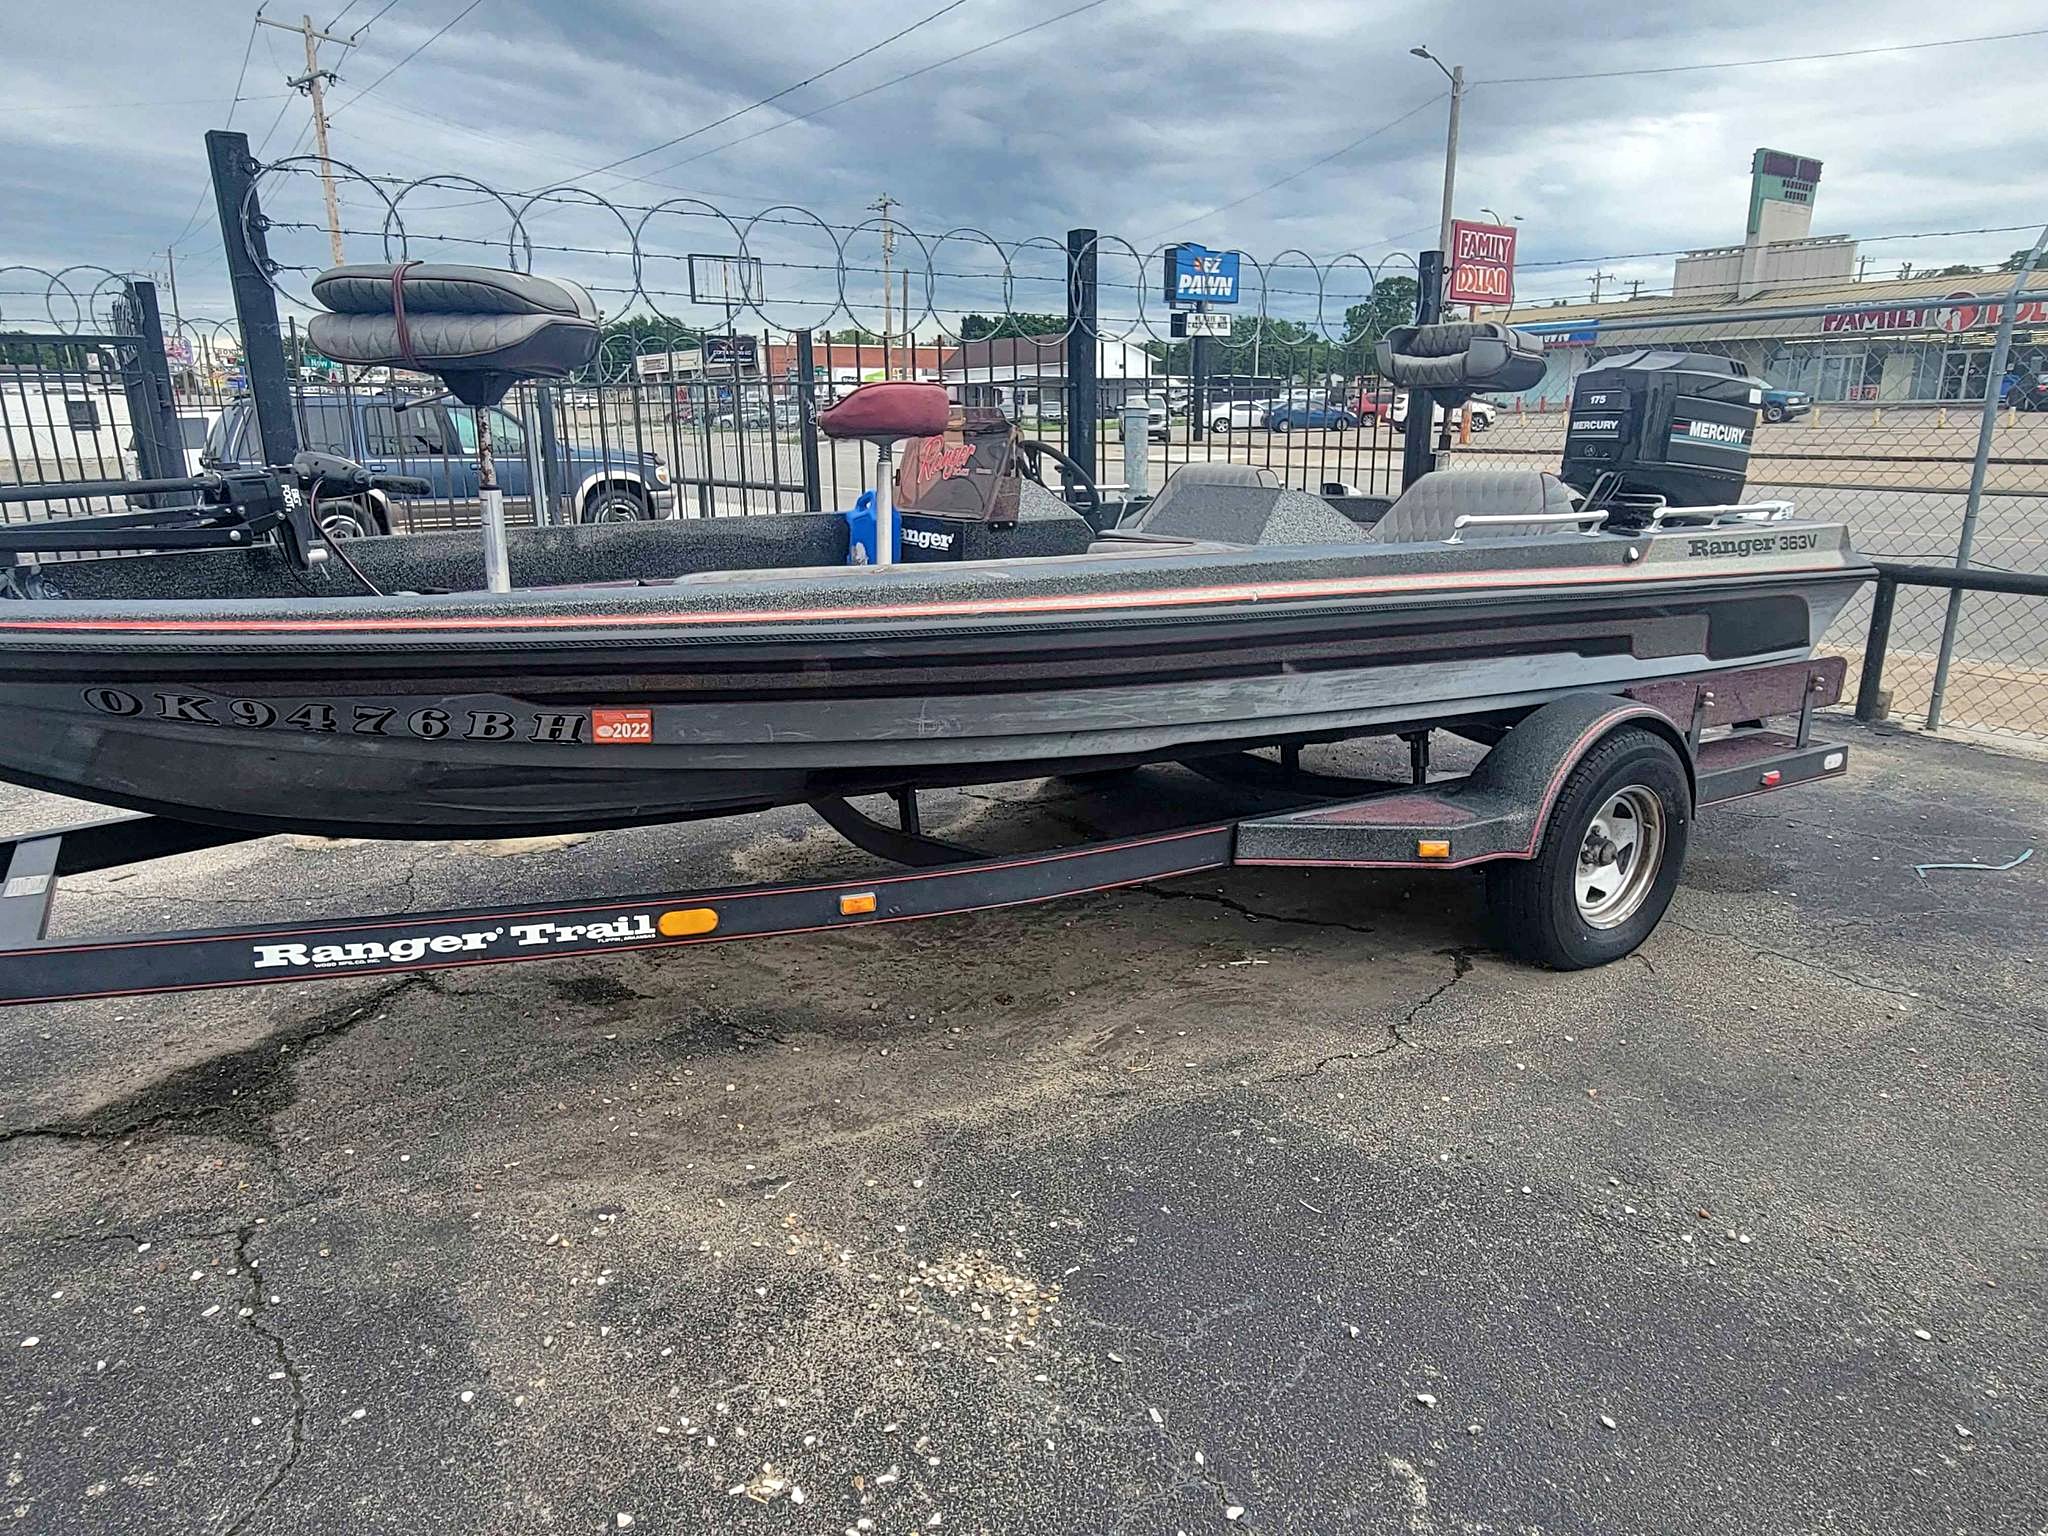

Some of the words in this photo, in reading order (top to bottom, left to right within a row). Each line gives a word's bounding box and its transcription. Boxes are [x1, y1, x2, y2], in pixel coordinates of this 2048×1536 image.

[1459, 230, 1513, 263] FAMILY
[1178, 274, 1233, 296] PAWN
[1822, 303, 1930, 333] FAMILY
[1590, 395, 1607, 405] 175
[1572, 420, 1619, 430] MERCURY
[1689, 421, 1747, 443] MERCURY
[281, 484, 295, 509] FOOT
[290, 488, 302, 507] BIG
[901, 528, 954, 548] anger
[1688, 537, 1776, 557] Ranger
[1779, 534, 1818, 550] 363V
[612, 722, 650, 738] 2022
[510, 914, 656, 946] Trail
